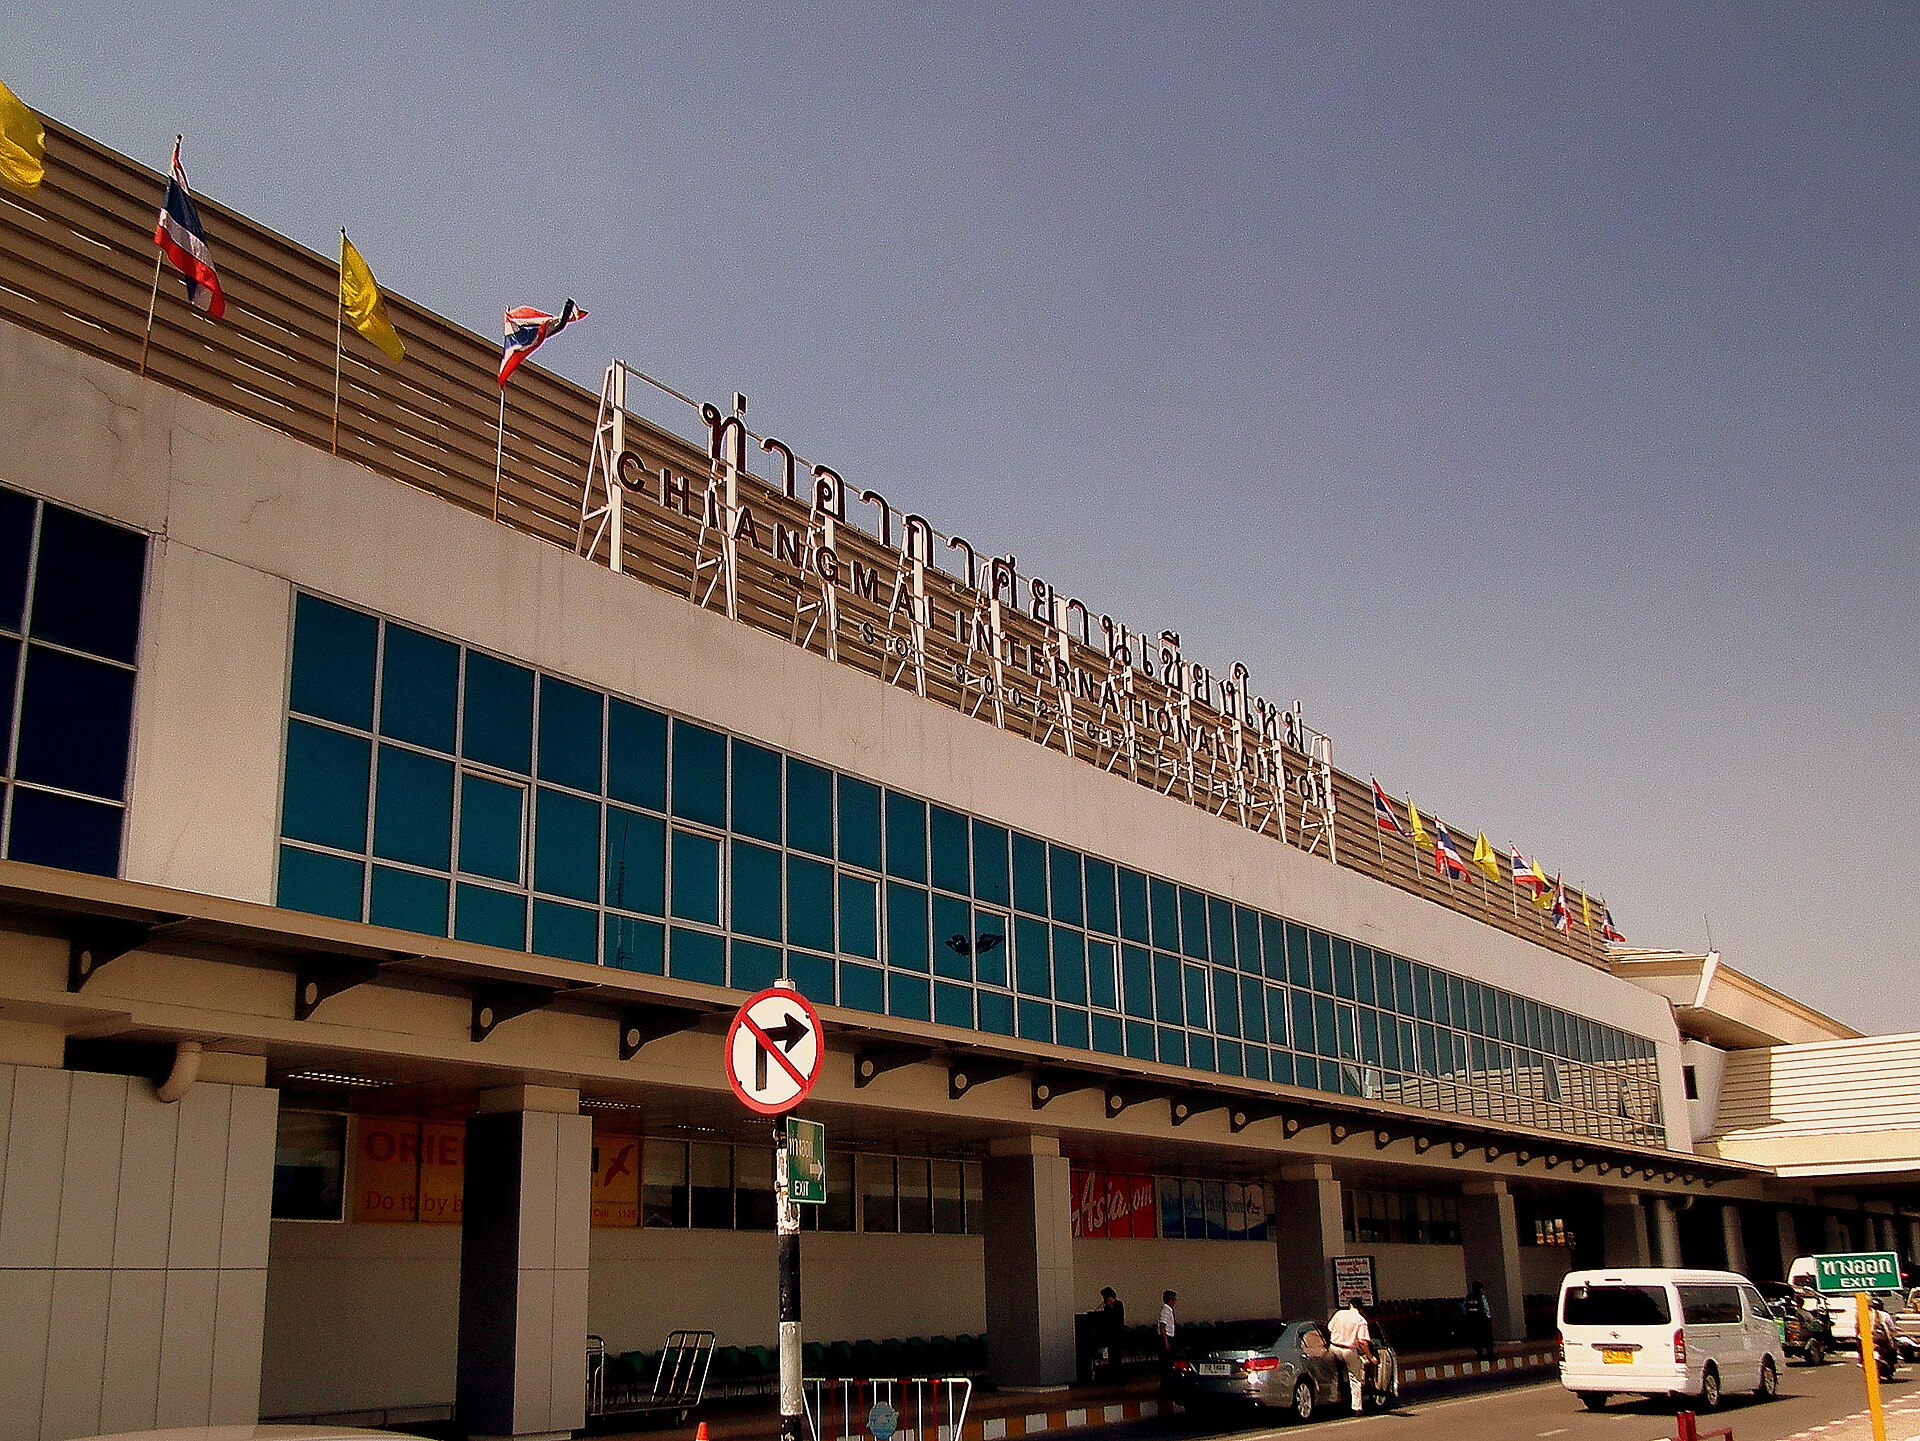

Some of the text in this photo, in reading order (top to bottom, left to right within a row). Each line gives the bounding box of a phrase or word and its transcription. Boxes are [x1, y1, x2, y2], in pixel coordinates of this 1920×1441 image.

[364, 1130, 464, 1166] ORIE
[794, 1180, 810, 1197] EXIT
[365, 1190, 395, 1211] Do
[422, 1194, 449, 1216] by
[1821, 1258, 1893, 1276] ทางออก
[1840, 1276, 1877, 1288] EXIT
